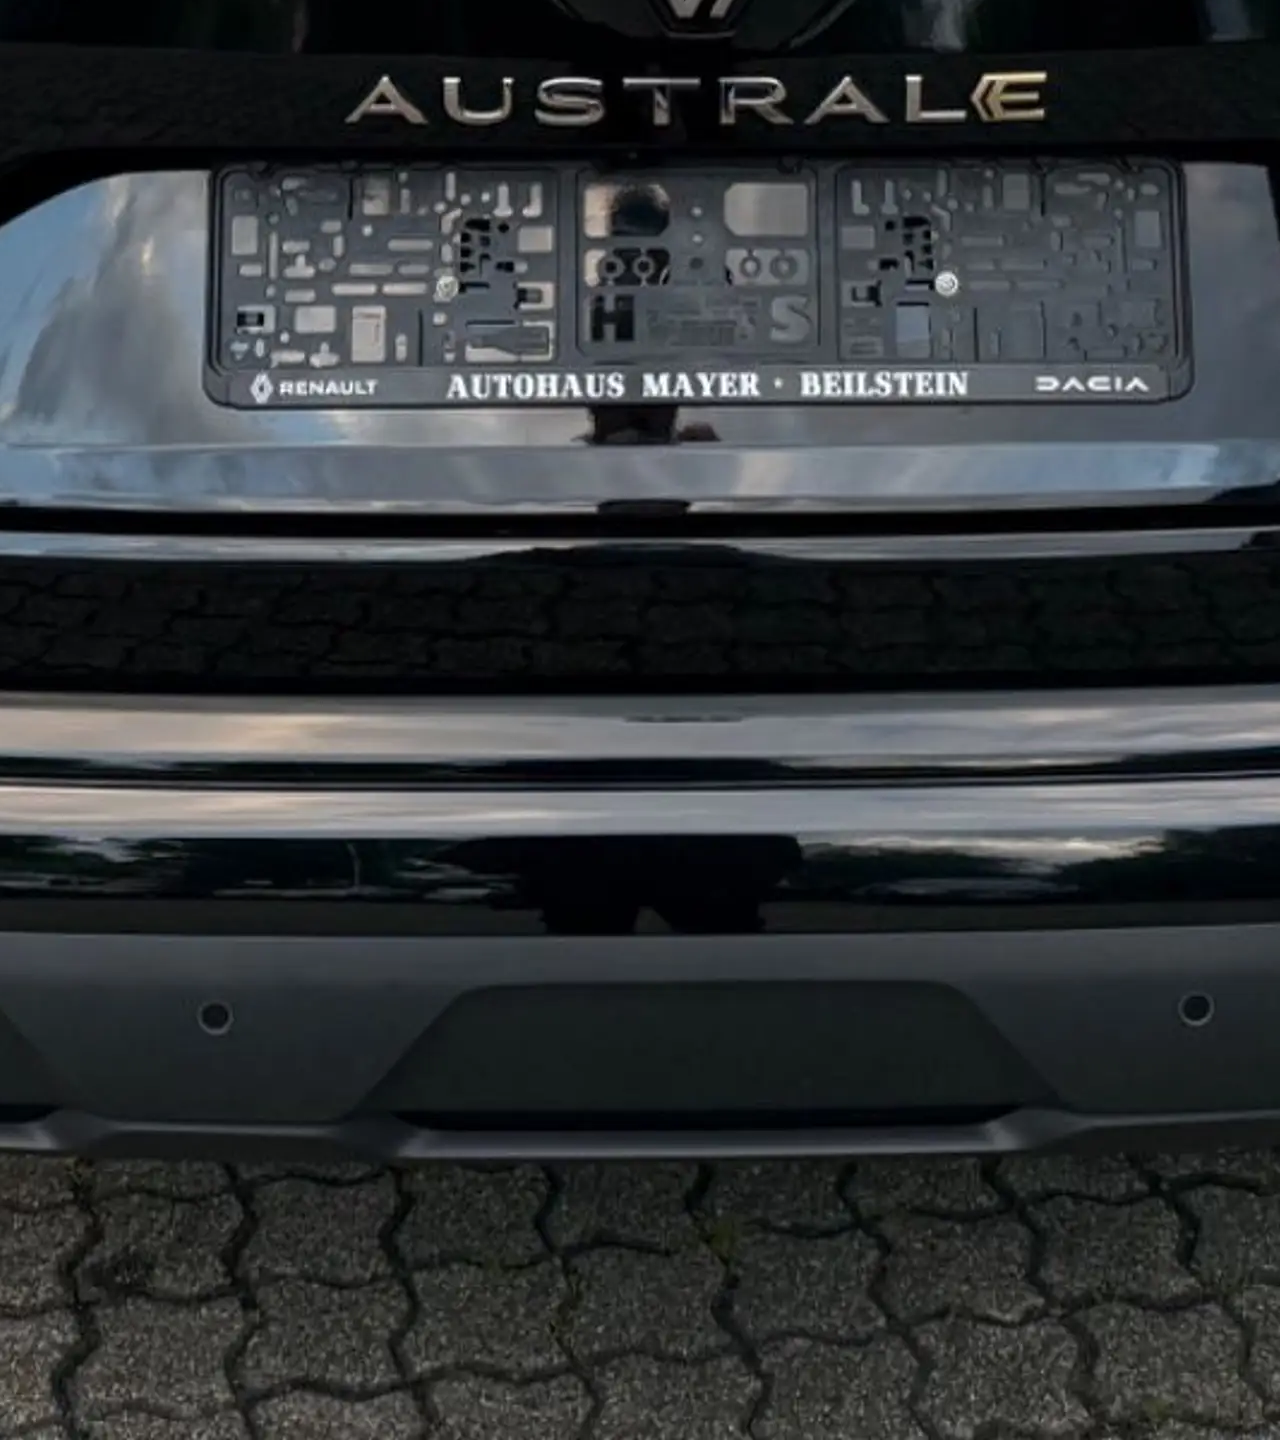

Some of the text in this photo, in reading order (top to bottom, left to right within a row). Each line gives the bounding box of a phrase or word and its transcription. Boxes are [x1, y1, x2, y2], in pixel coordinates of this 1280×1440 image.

[344, 71, 1048, 126] AUSTRALE
[279, 379, 379, 396] RENAULT
[445, 370, 969, 400] AUTOHAUS MAYER BEILSTEIN
[1034, 375, 1151, 393] DACIA
